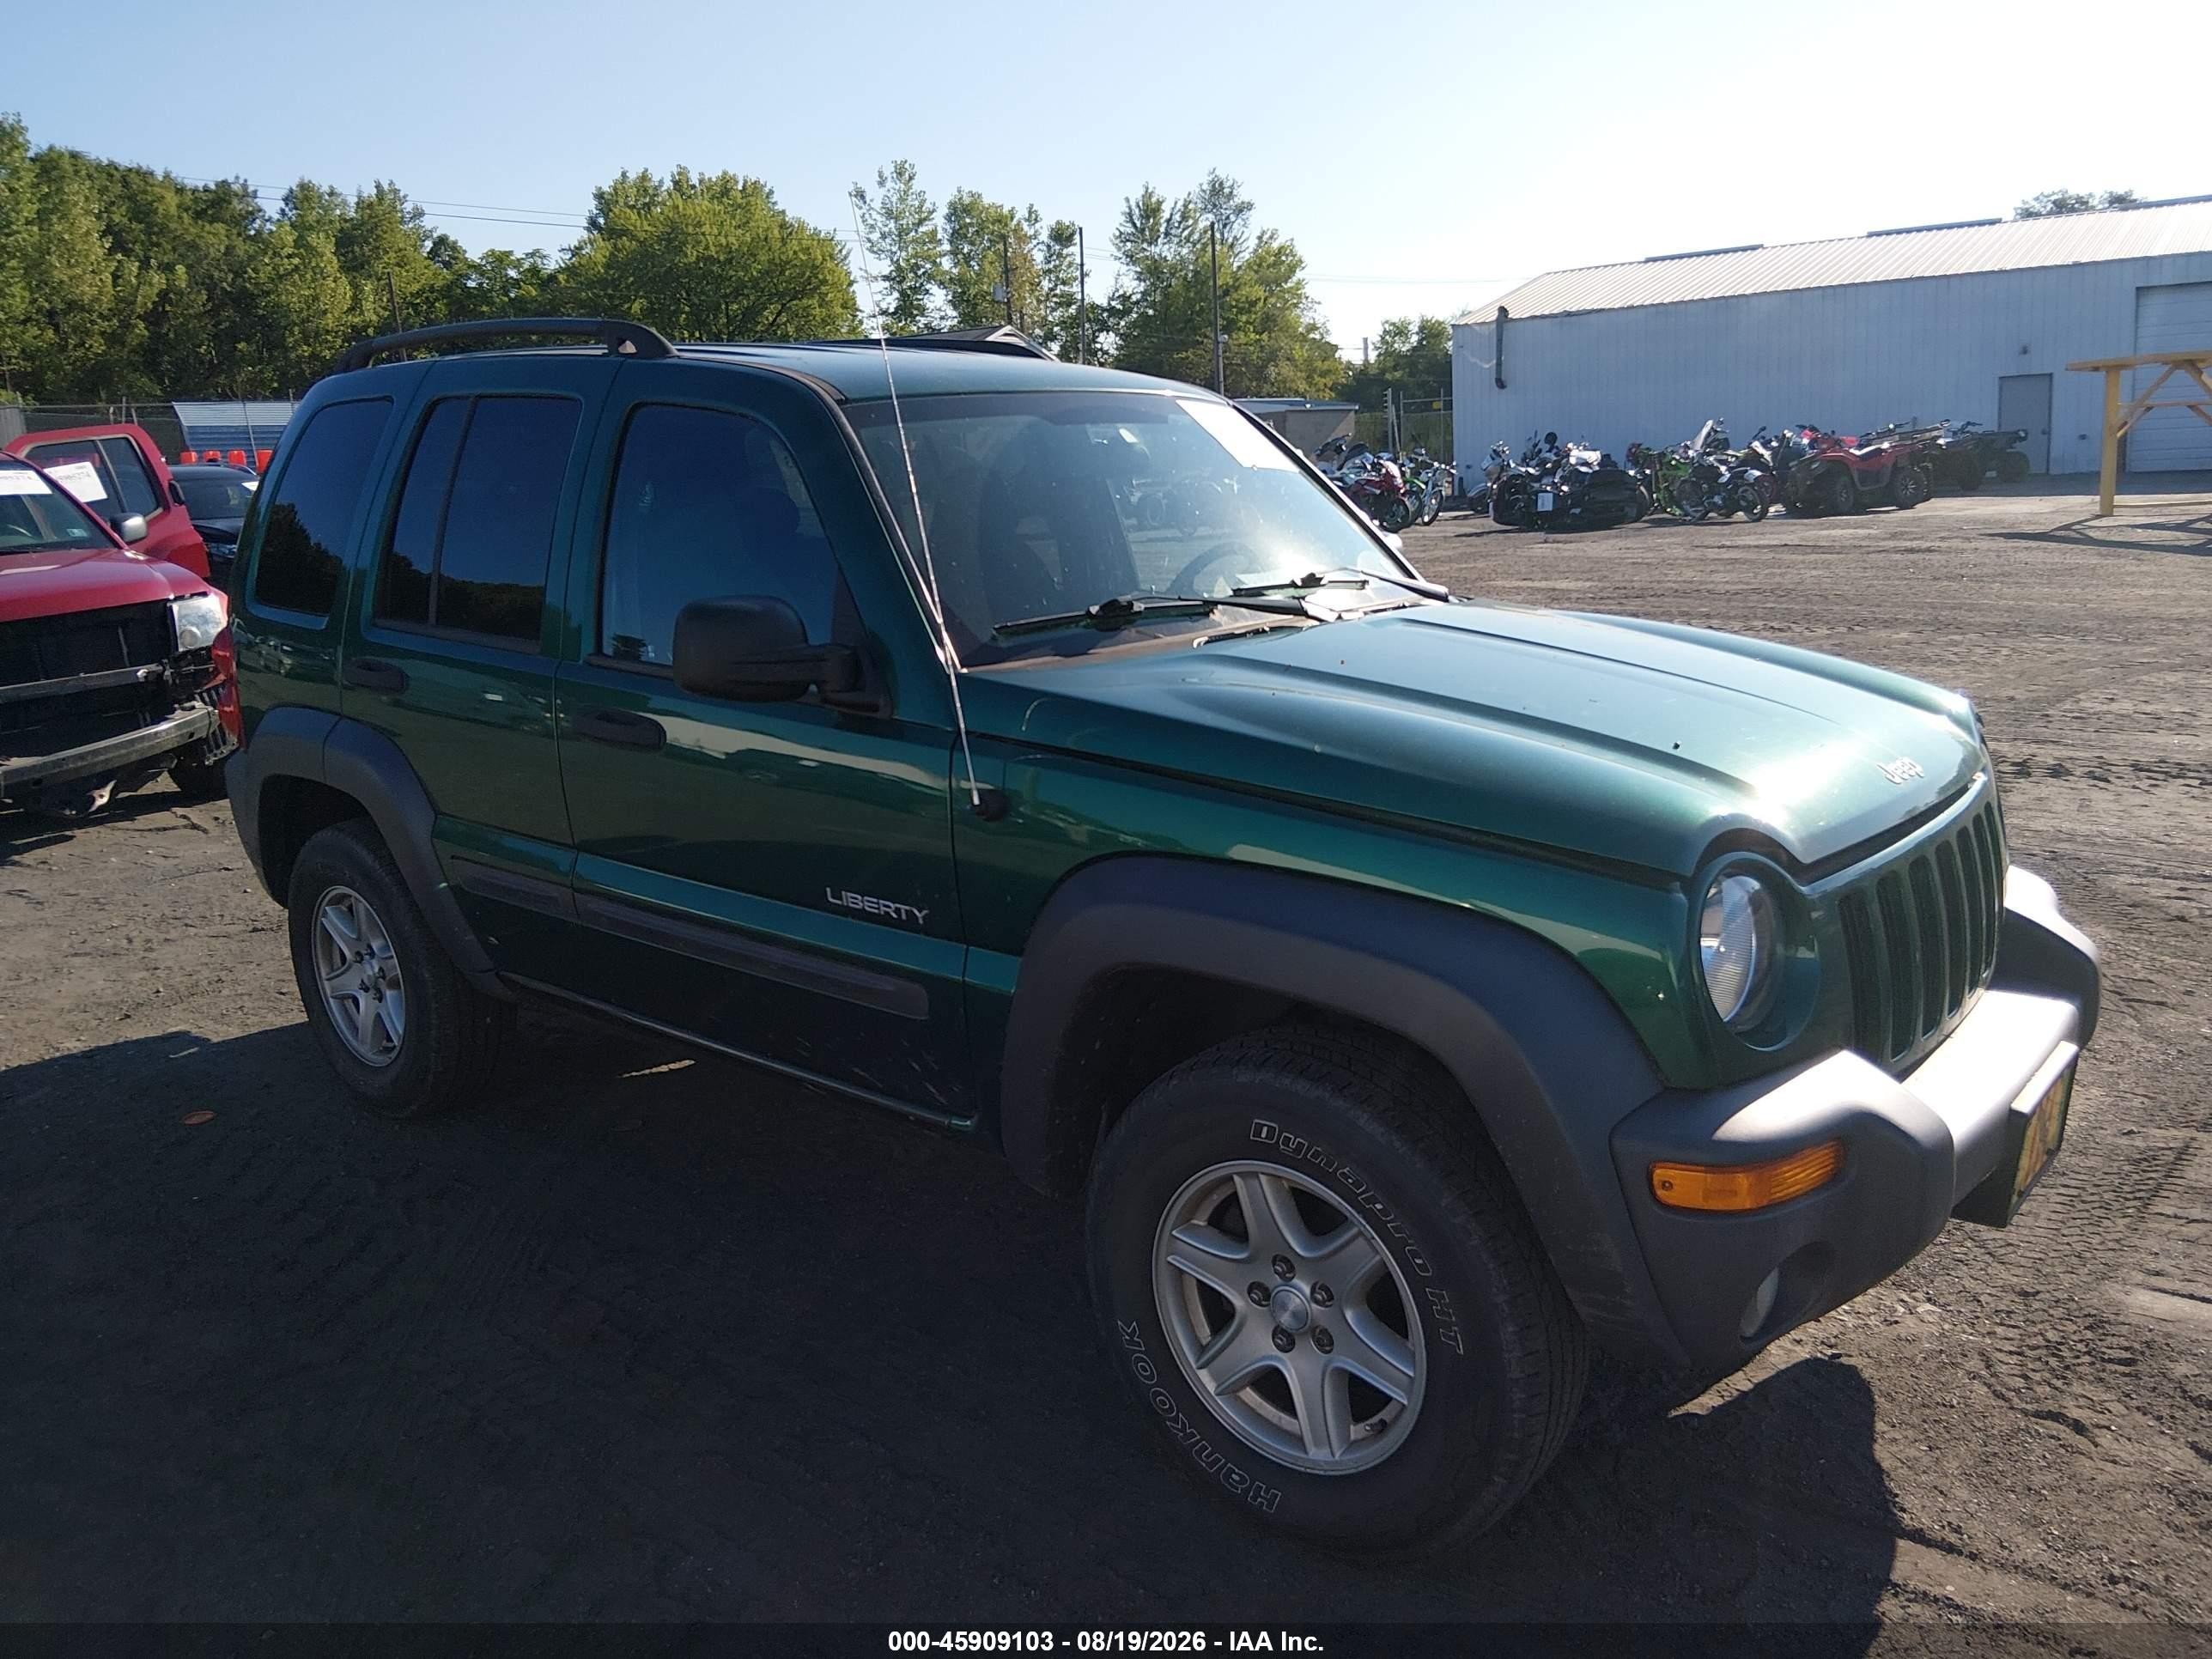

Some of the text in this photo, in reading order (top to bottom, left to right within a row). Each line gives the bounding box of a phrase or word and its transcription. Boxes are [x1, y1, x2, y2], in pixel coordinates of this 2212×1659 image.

[1875, 757, 1925, 785] Jeep
[825, 887, 930, 925] LIBERTY
[1249, 1119, 1464, 1355] Dynapro HT
